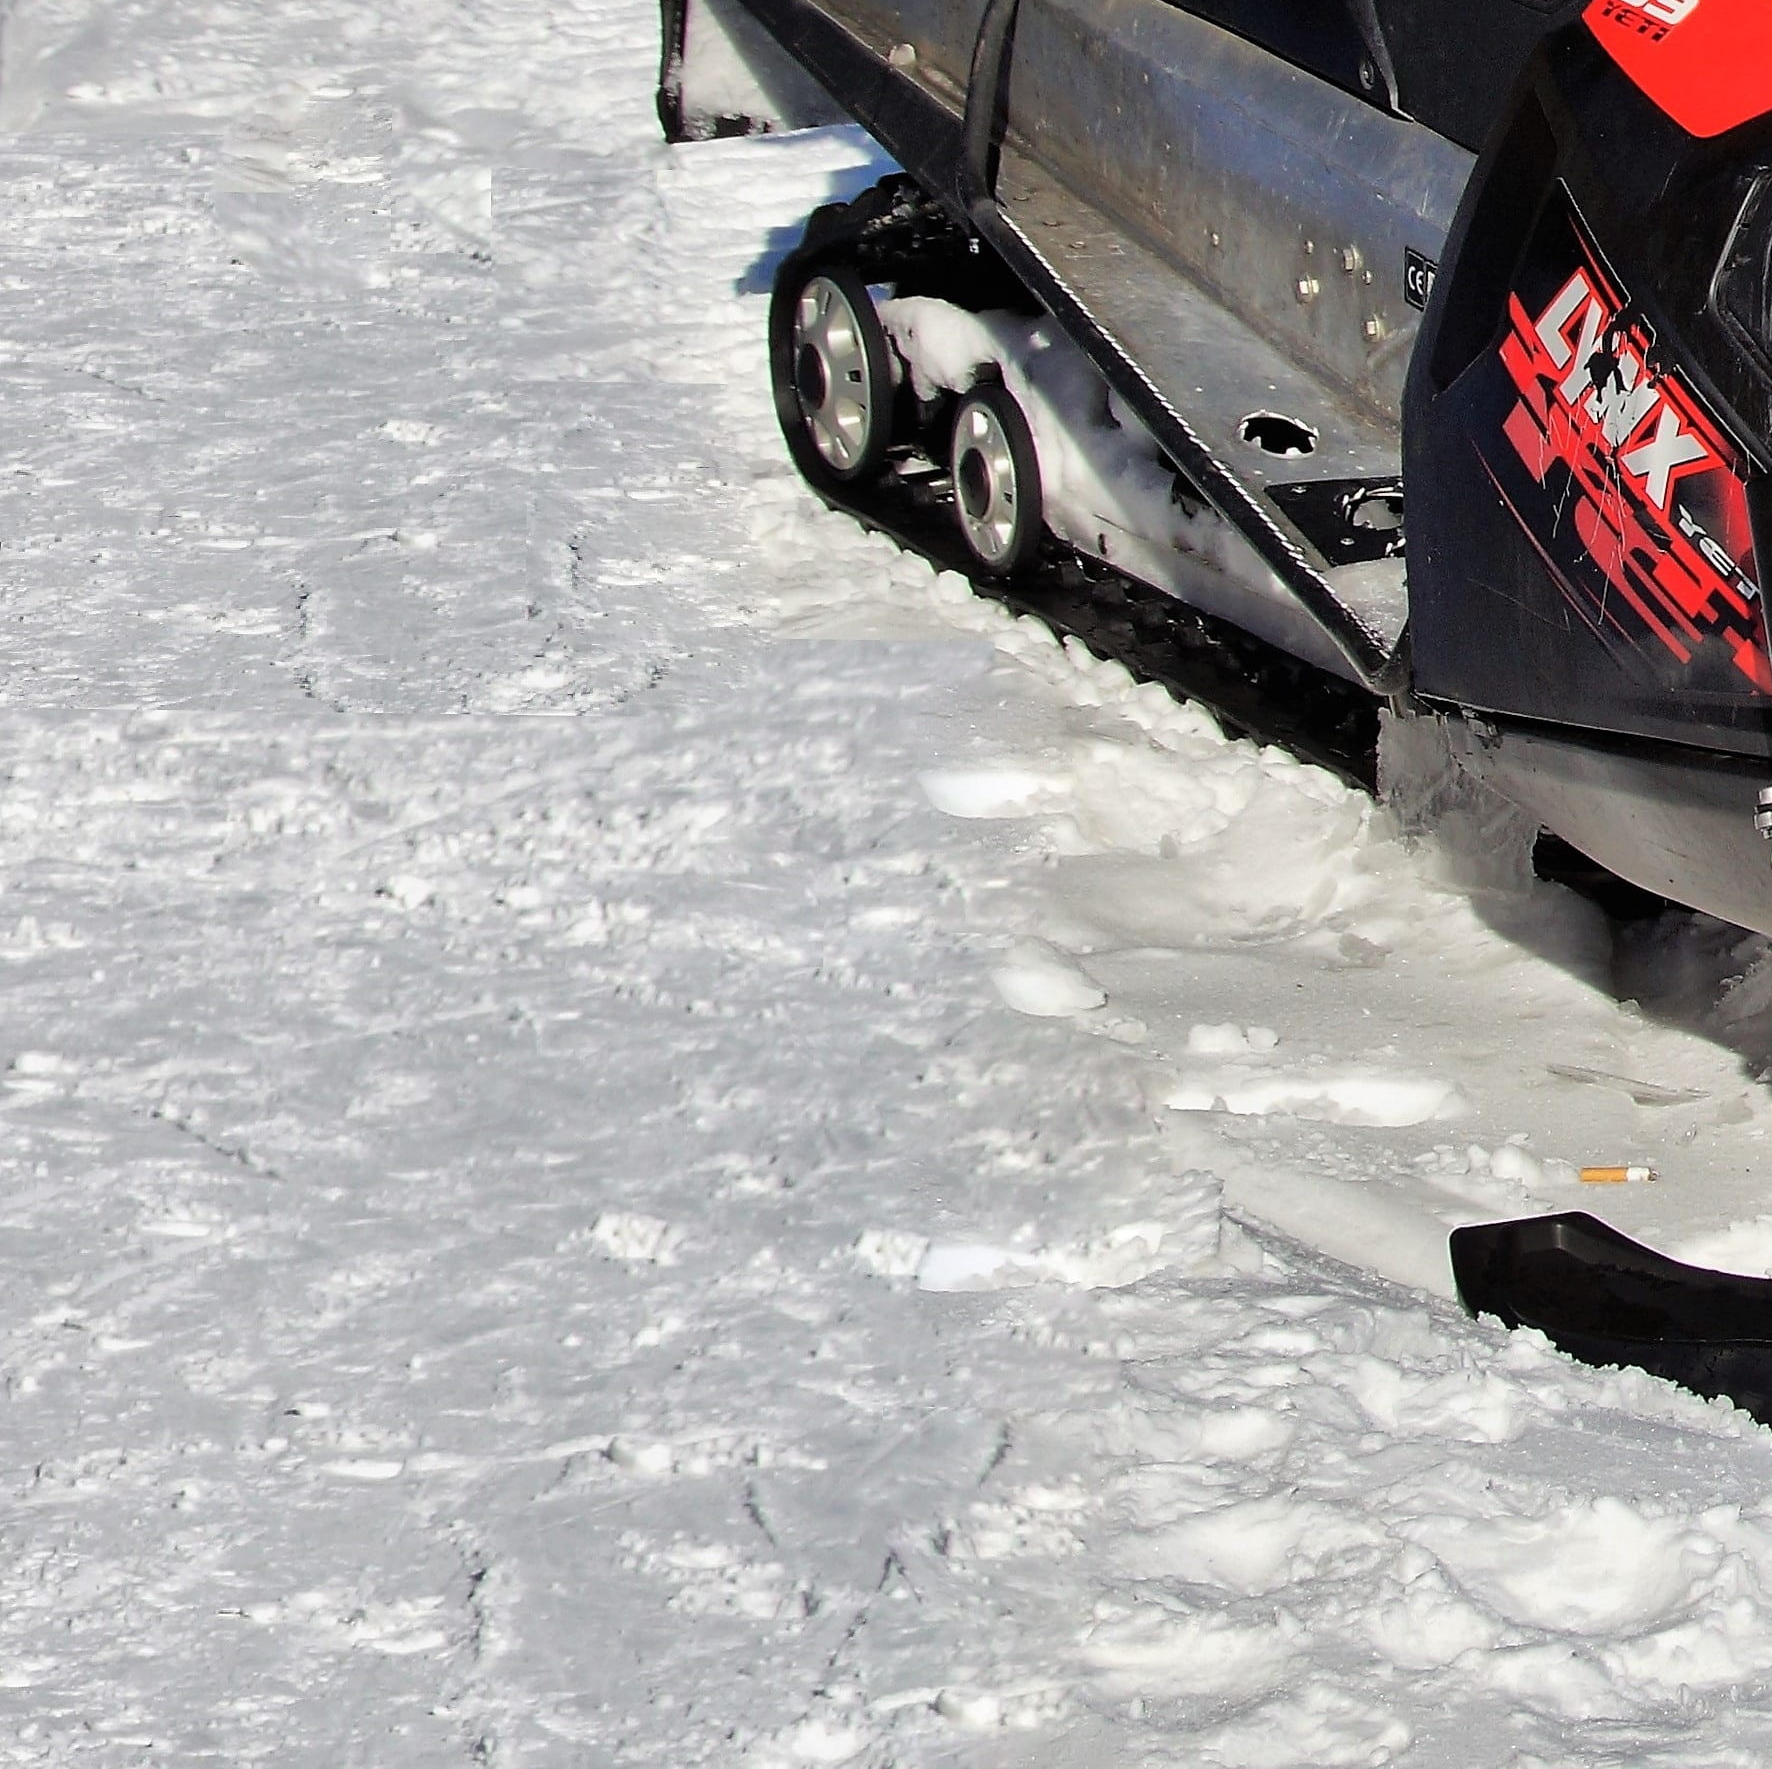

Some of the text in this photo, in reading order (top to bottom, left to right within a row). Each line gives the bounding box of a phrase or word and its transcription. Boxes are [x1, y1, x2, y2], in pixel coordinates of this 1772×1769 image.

[1602, 0, 1671, 42] YETI
[1408, 265, 1425, 296] CE
[1678, 503, 1761, 600] YET
